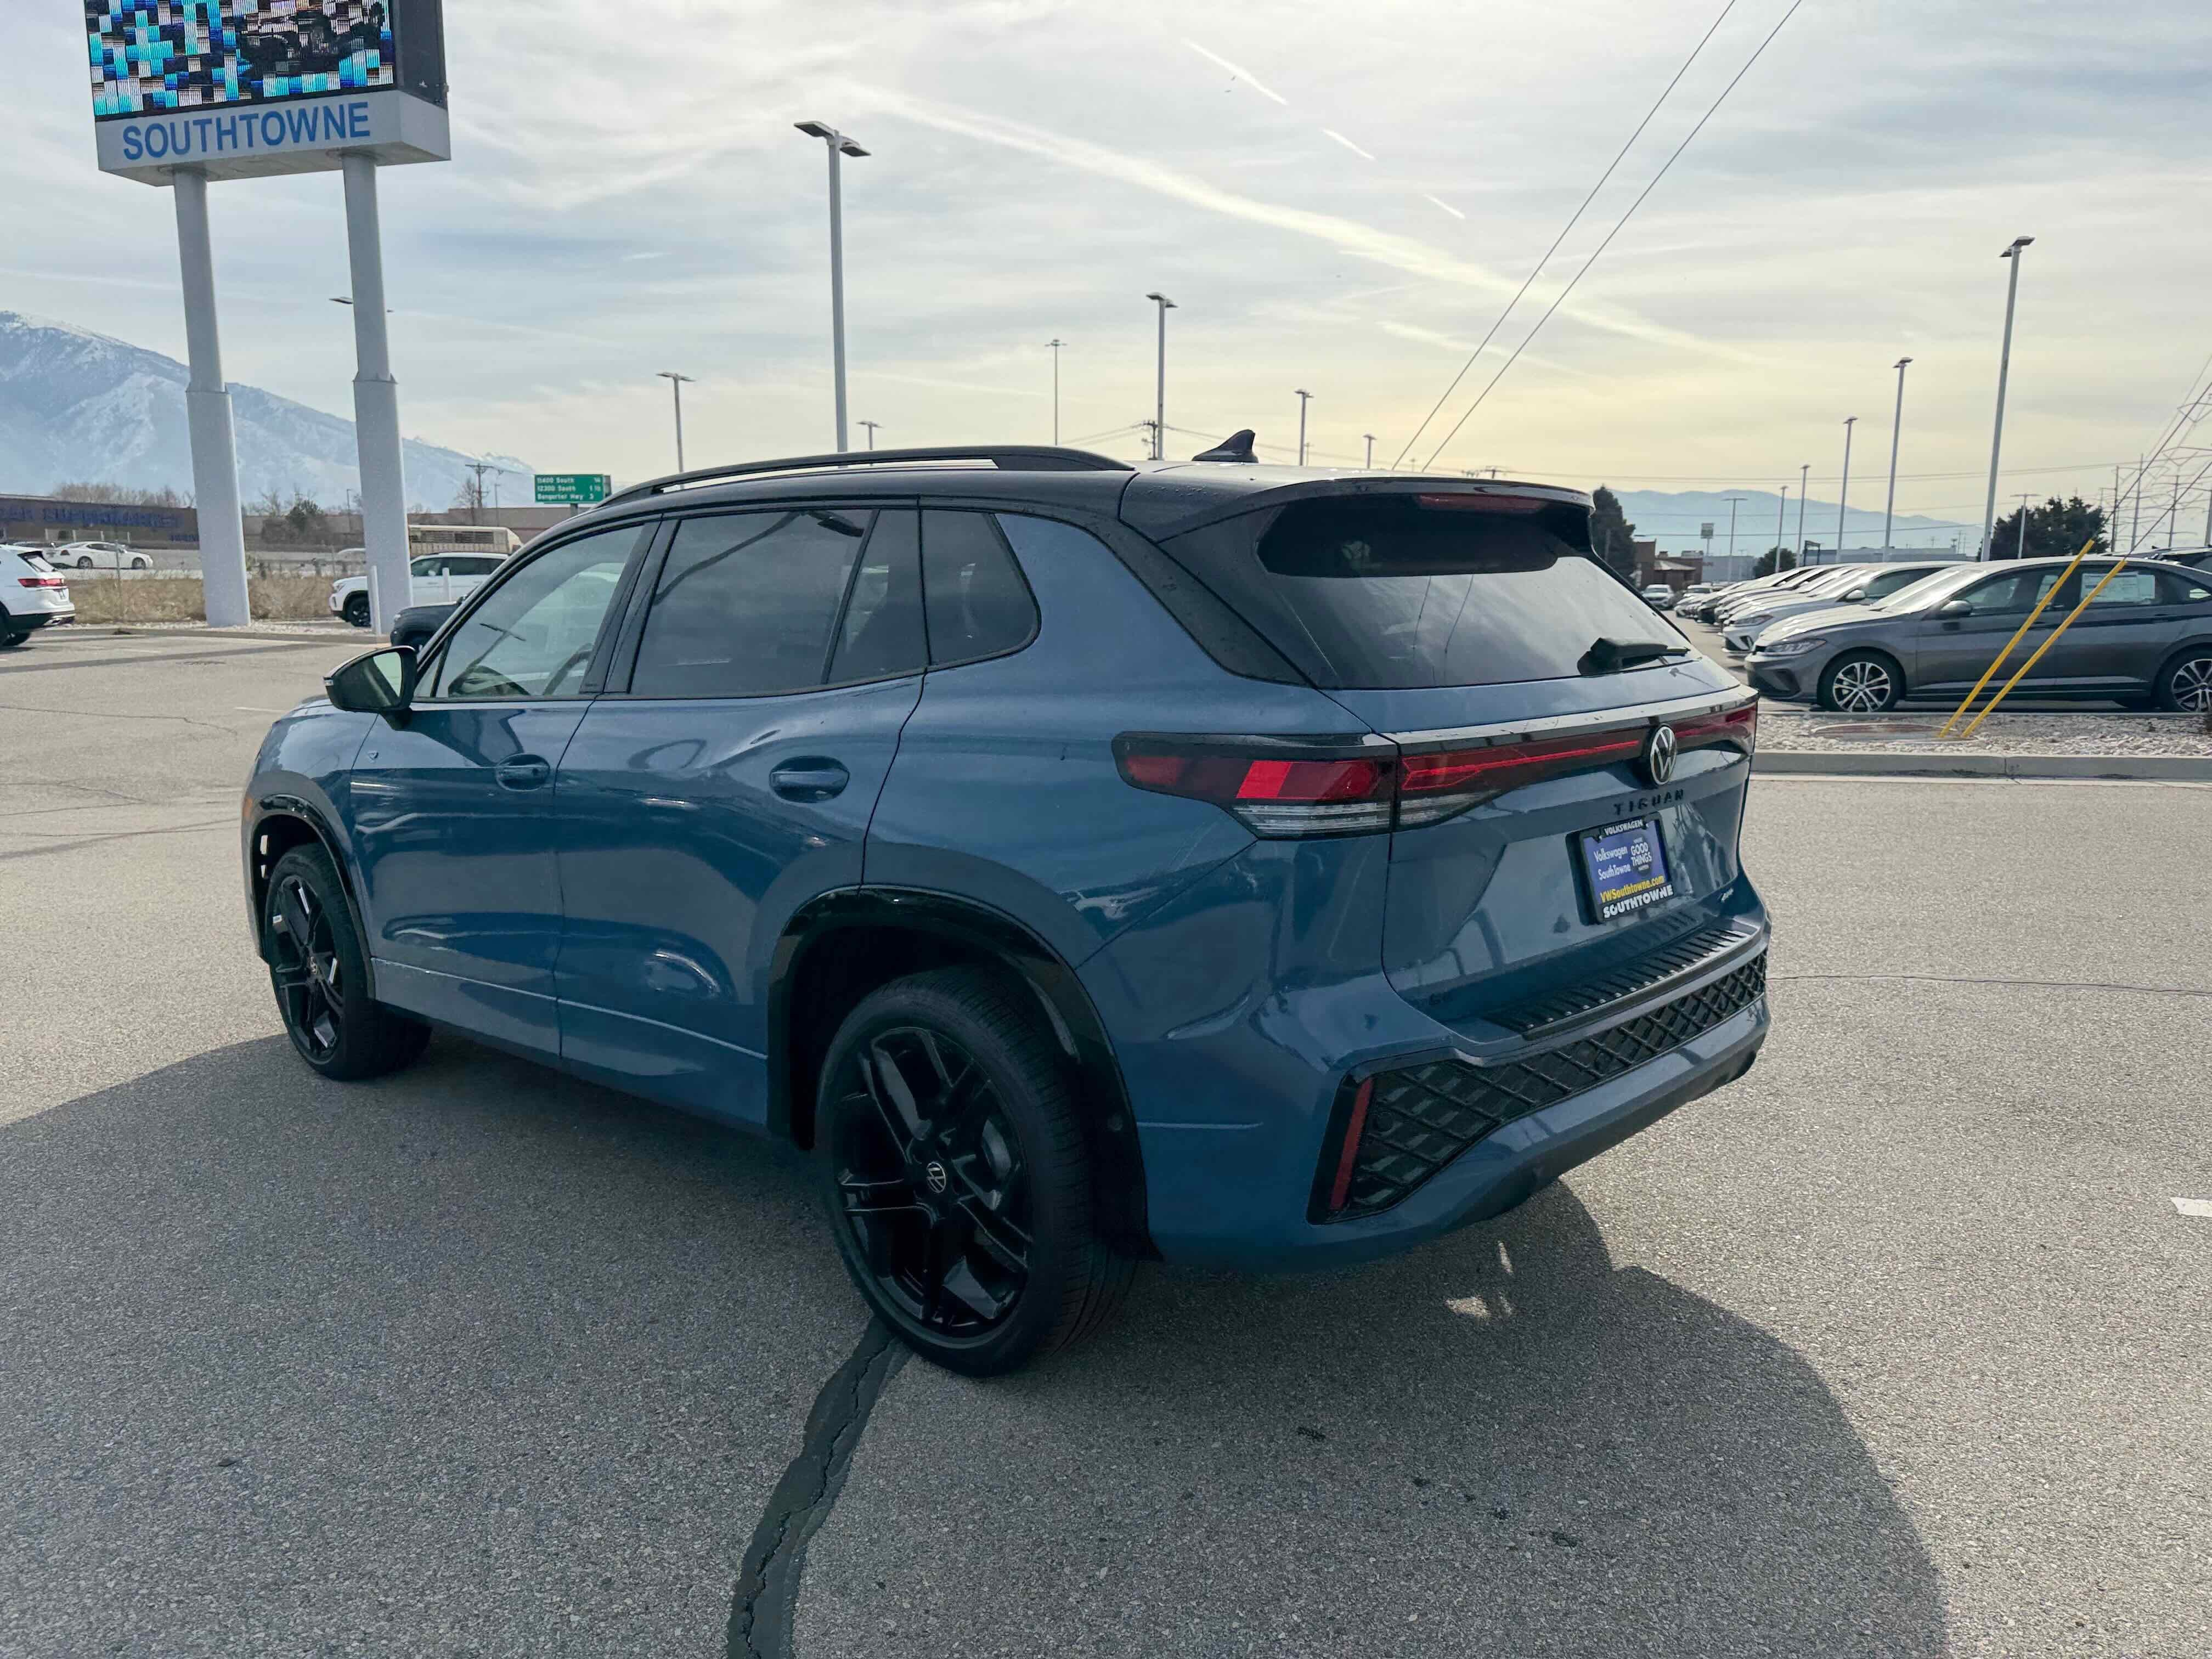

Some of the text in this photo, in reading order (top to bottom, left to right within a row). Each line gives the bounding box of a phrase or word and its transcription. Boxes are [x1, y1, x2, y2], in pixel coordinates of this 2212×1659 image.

[123, 102, 370, 160] SOUTHTOWNE
[1613, 789, 1684, 816] TIGUAN
[1604, 819, 1644, 836] VOLKSWAGEN
[1594, 847, 1628, 862] Volkswagen
[1630, 842, 1649, 856] GOOD
[1630, 851, 1652, 866] THINGS
[1600, 875, 1664, 903] VWSouthtowne.com
[1603, 884, 1674, 918] SOUTHTOWNE
